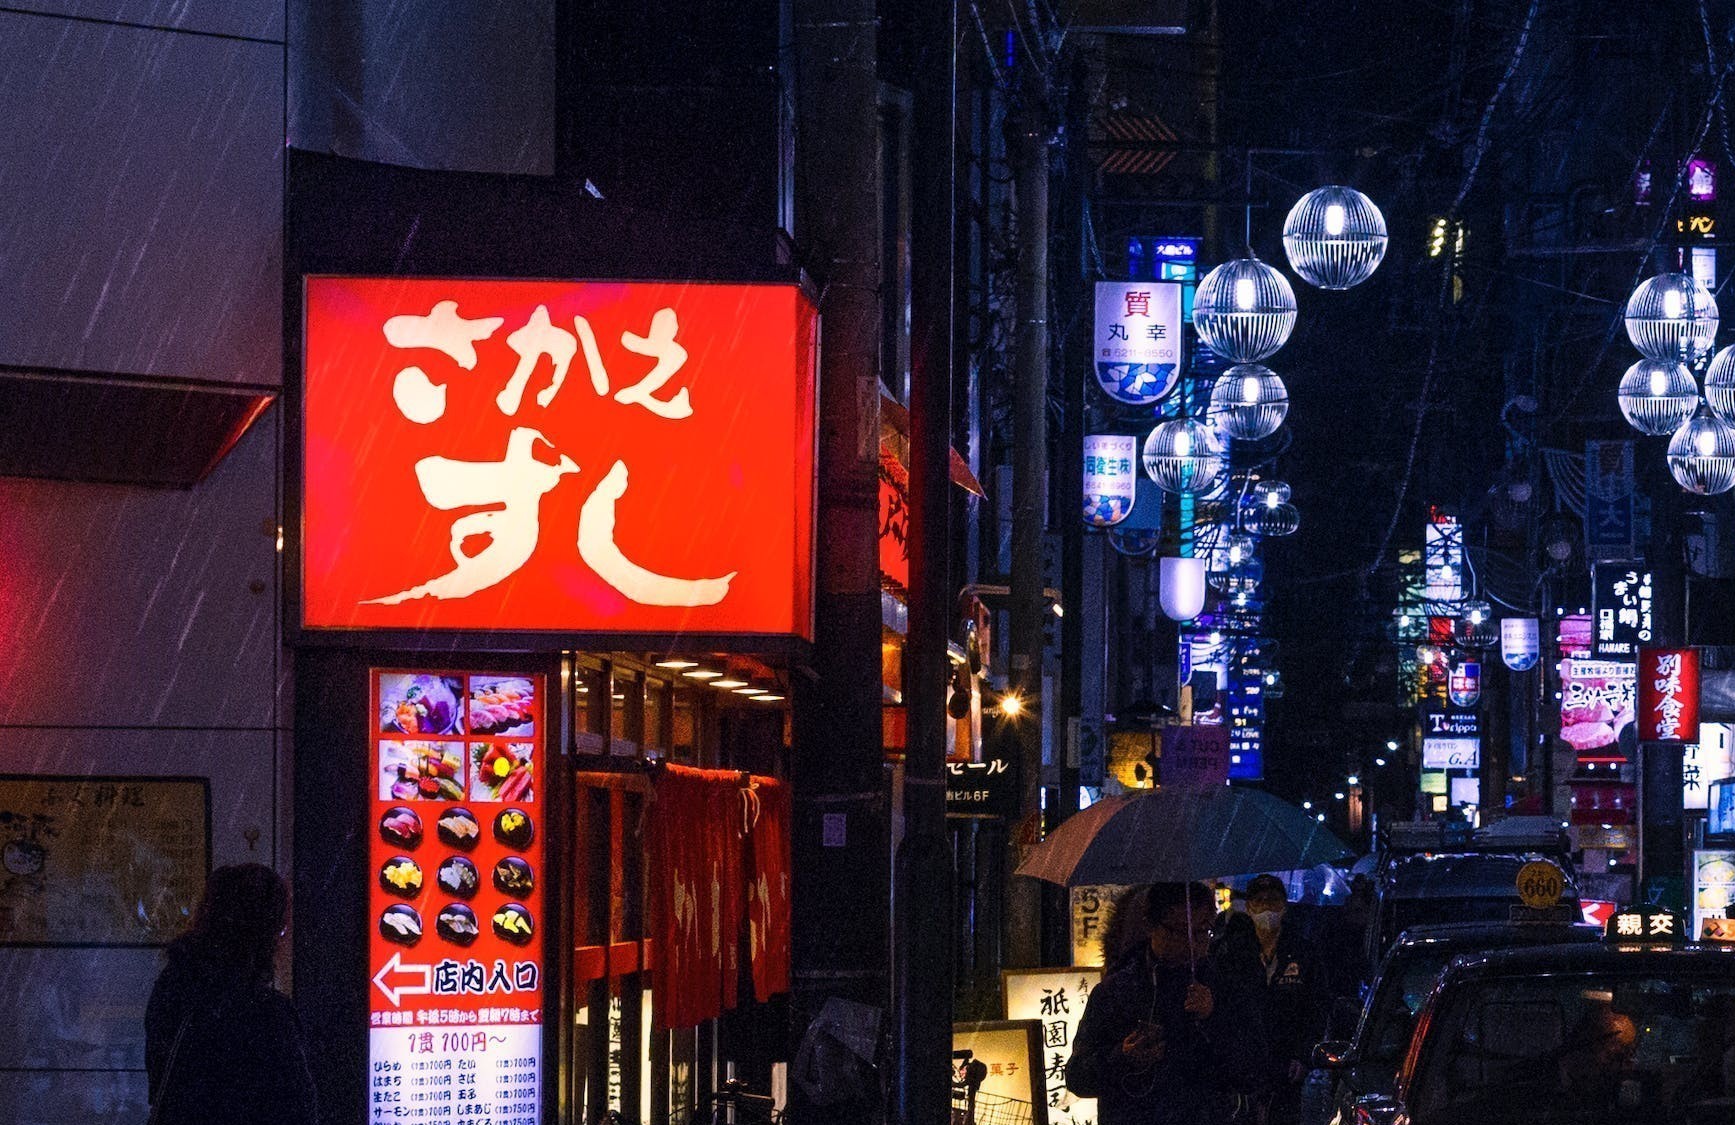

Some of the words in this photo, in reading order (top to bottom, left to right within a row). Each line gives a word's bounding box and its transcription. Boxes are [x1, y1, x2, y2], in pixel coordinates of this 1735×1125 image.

[1125, 291, 1151, 317] 質
[383, 300, 693, 424] さかえ
[358, 427, 738, 606] すし
[1655, 653, 1684, 740] 別味食堂
[1617, 914, 1673, 935] 親交
[434, 960, 538, 994] 店内入口
[374, 1062, 401, 1071] ひらめ
[458, 1059, 475, 1069] たい
[374, 1076, 401, 1086] はまち
[458, 1074, 475, 1084] さば
[374, 1092, 400, 1102] 生たこ
[374, 1107, 409, 1117] サーモン
